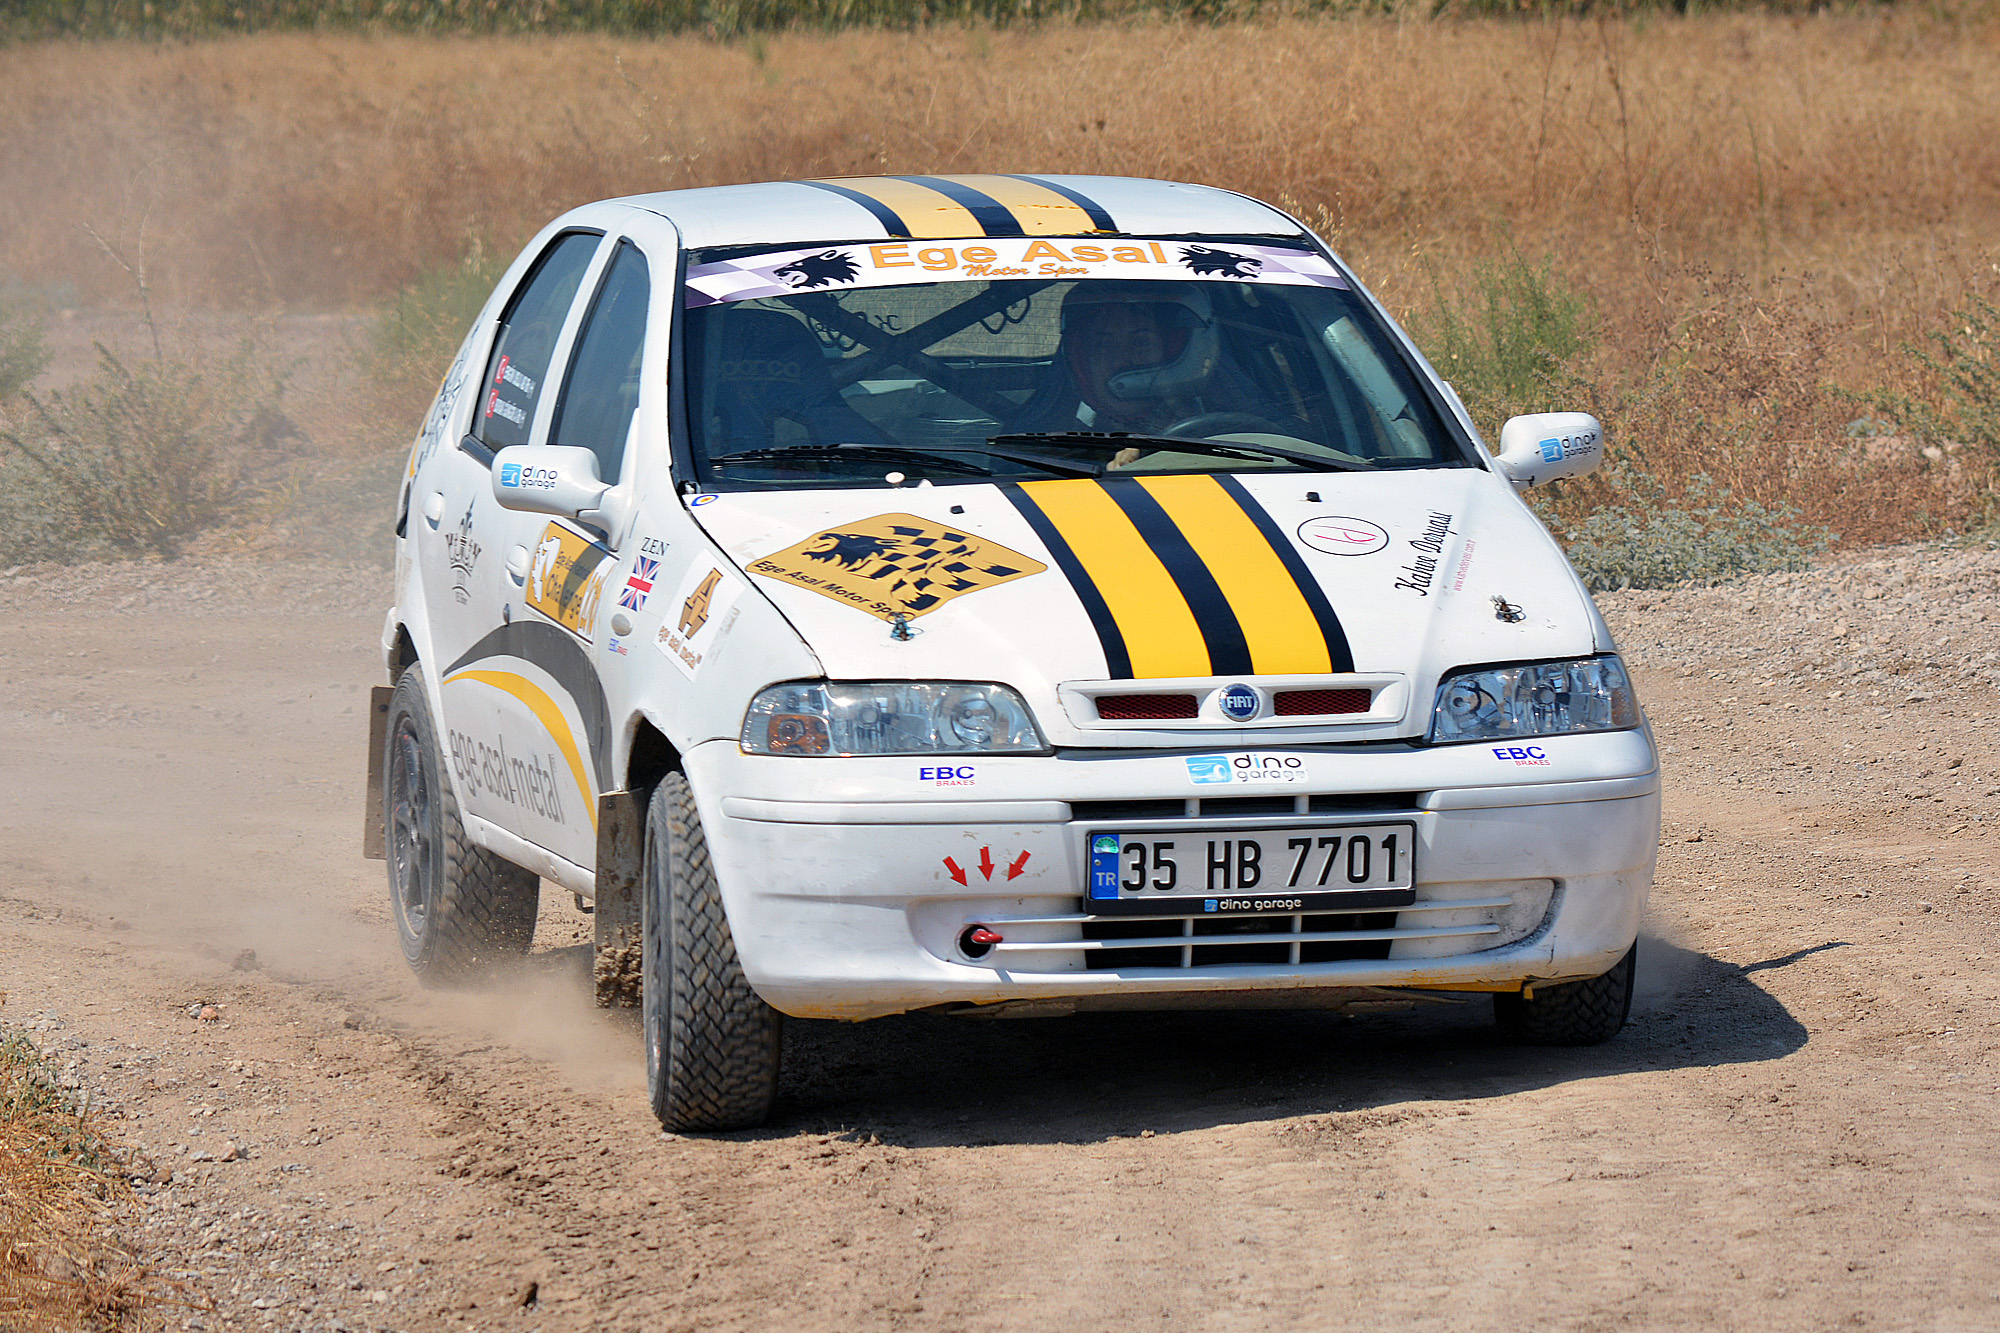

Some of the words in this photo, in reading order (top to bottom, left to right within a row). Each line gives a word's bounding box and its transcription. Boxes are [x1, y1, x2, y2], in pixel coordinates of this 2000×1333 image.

[869, 243, 998, 271] Ege
[1020, 240, 1168, 264] Asal
[962, 264, 1030, 276] Motor
[1038, 263, 1089, 277] Spor
[1561, 433, 1591, 449] dino
[522, 465, 558, 480] dino
[521, 478, 556, 490] garage
[640, 536, 670, 556] ZEN
[754, 560, 787, 574] Ege
[785, 571, 827, 586] Asal
[821, 583, 872, 604] Motor
[1226, 695, 1253, 709] FIAT
[1491, 746, 1546, 760] EBC
[1233, 754, 1302, 769] dino
[449, 729, 482, 798] ege
[478, 733, 516, 804] asal
[511, 753, 565, 826] metal
[919, 766, 975, 780] EBC
[1236, 770, 1306, 783] garage
[1122, 842, 1177, 891] 35
[1206, 840, 1261, 890] HB
[1287, 834, 1397, 887] 7701
[1095, 872, 1116, 886] TR
[1219, 898, 1252, 910] dino
[1254, 898, 1303, 911] garage
